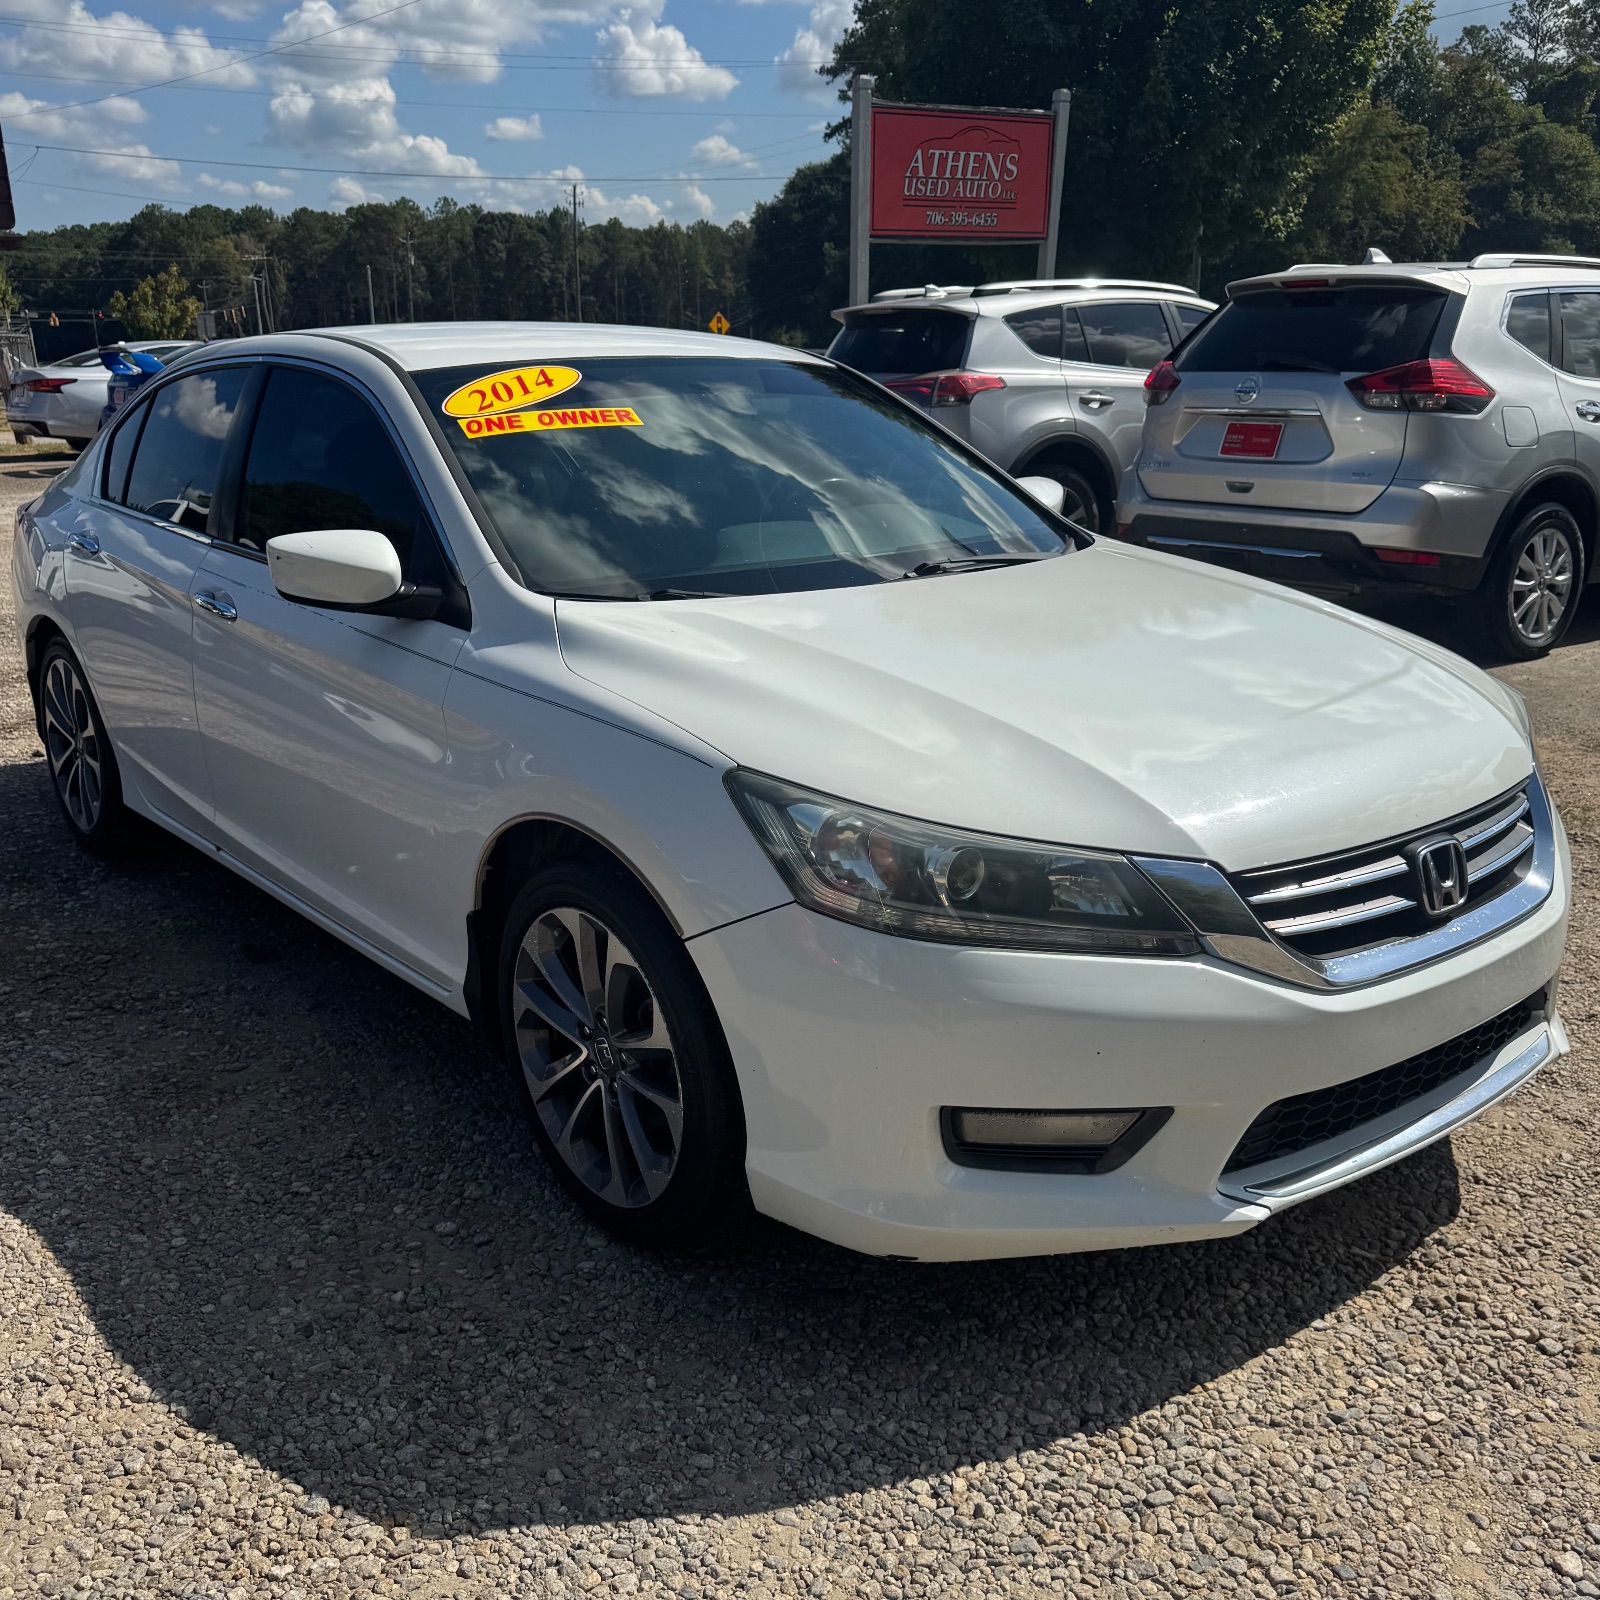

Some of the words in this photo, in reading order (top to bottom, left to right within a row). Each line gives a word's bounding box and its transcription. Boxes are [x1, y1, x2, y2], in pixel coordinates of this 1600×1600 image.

[904, 148, 1019, 182] ATHENS
[903, 178, 950, 197] USED
[952, 180, 1002, 200] AUTO
[925, 210, 999, 227] 706-395-6455
[468, 368, 555, 413] 2014
[465, 414, 525, 435] ONE
[537, 409, 636, 427] OWNER
